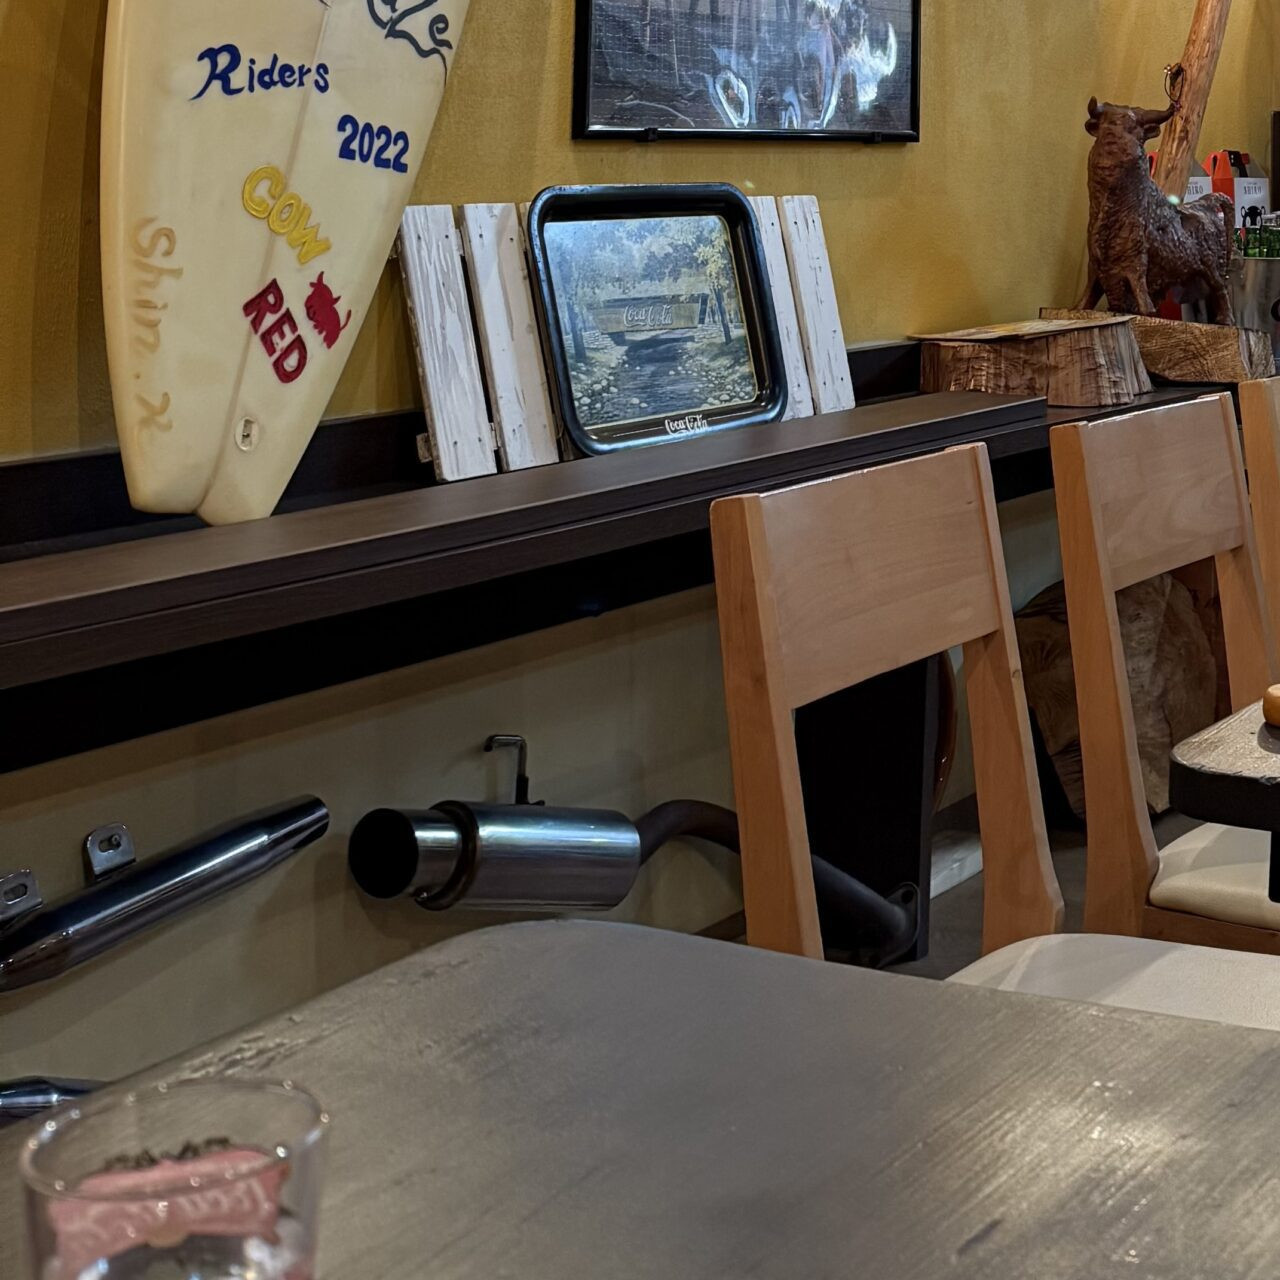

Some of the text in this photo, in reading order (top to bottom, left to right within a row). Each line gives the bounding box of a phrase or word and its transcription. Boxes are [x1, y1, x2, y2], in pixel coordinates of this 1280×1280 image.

[190, 45, 330, 102] Riders
[337, 114, 410, 173] 2022
[242, 165, 332, 266] COW
[243, 277, 309, 384] RED
